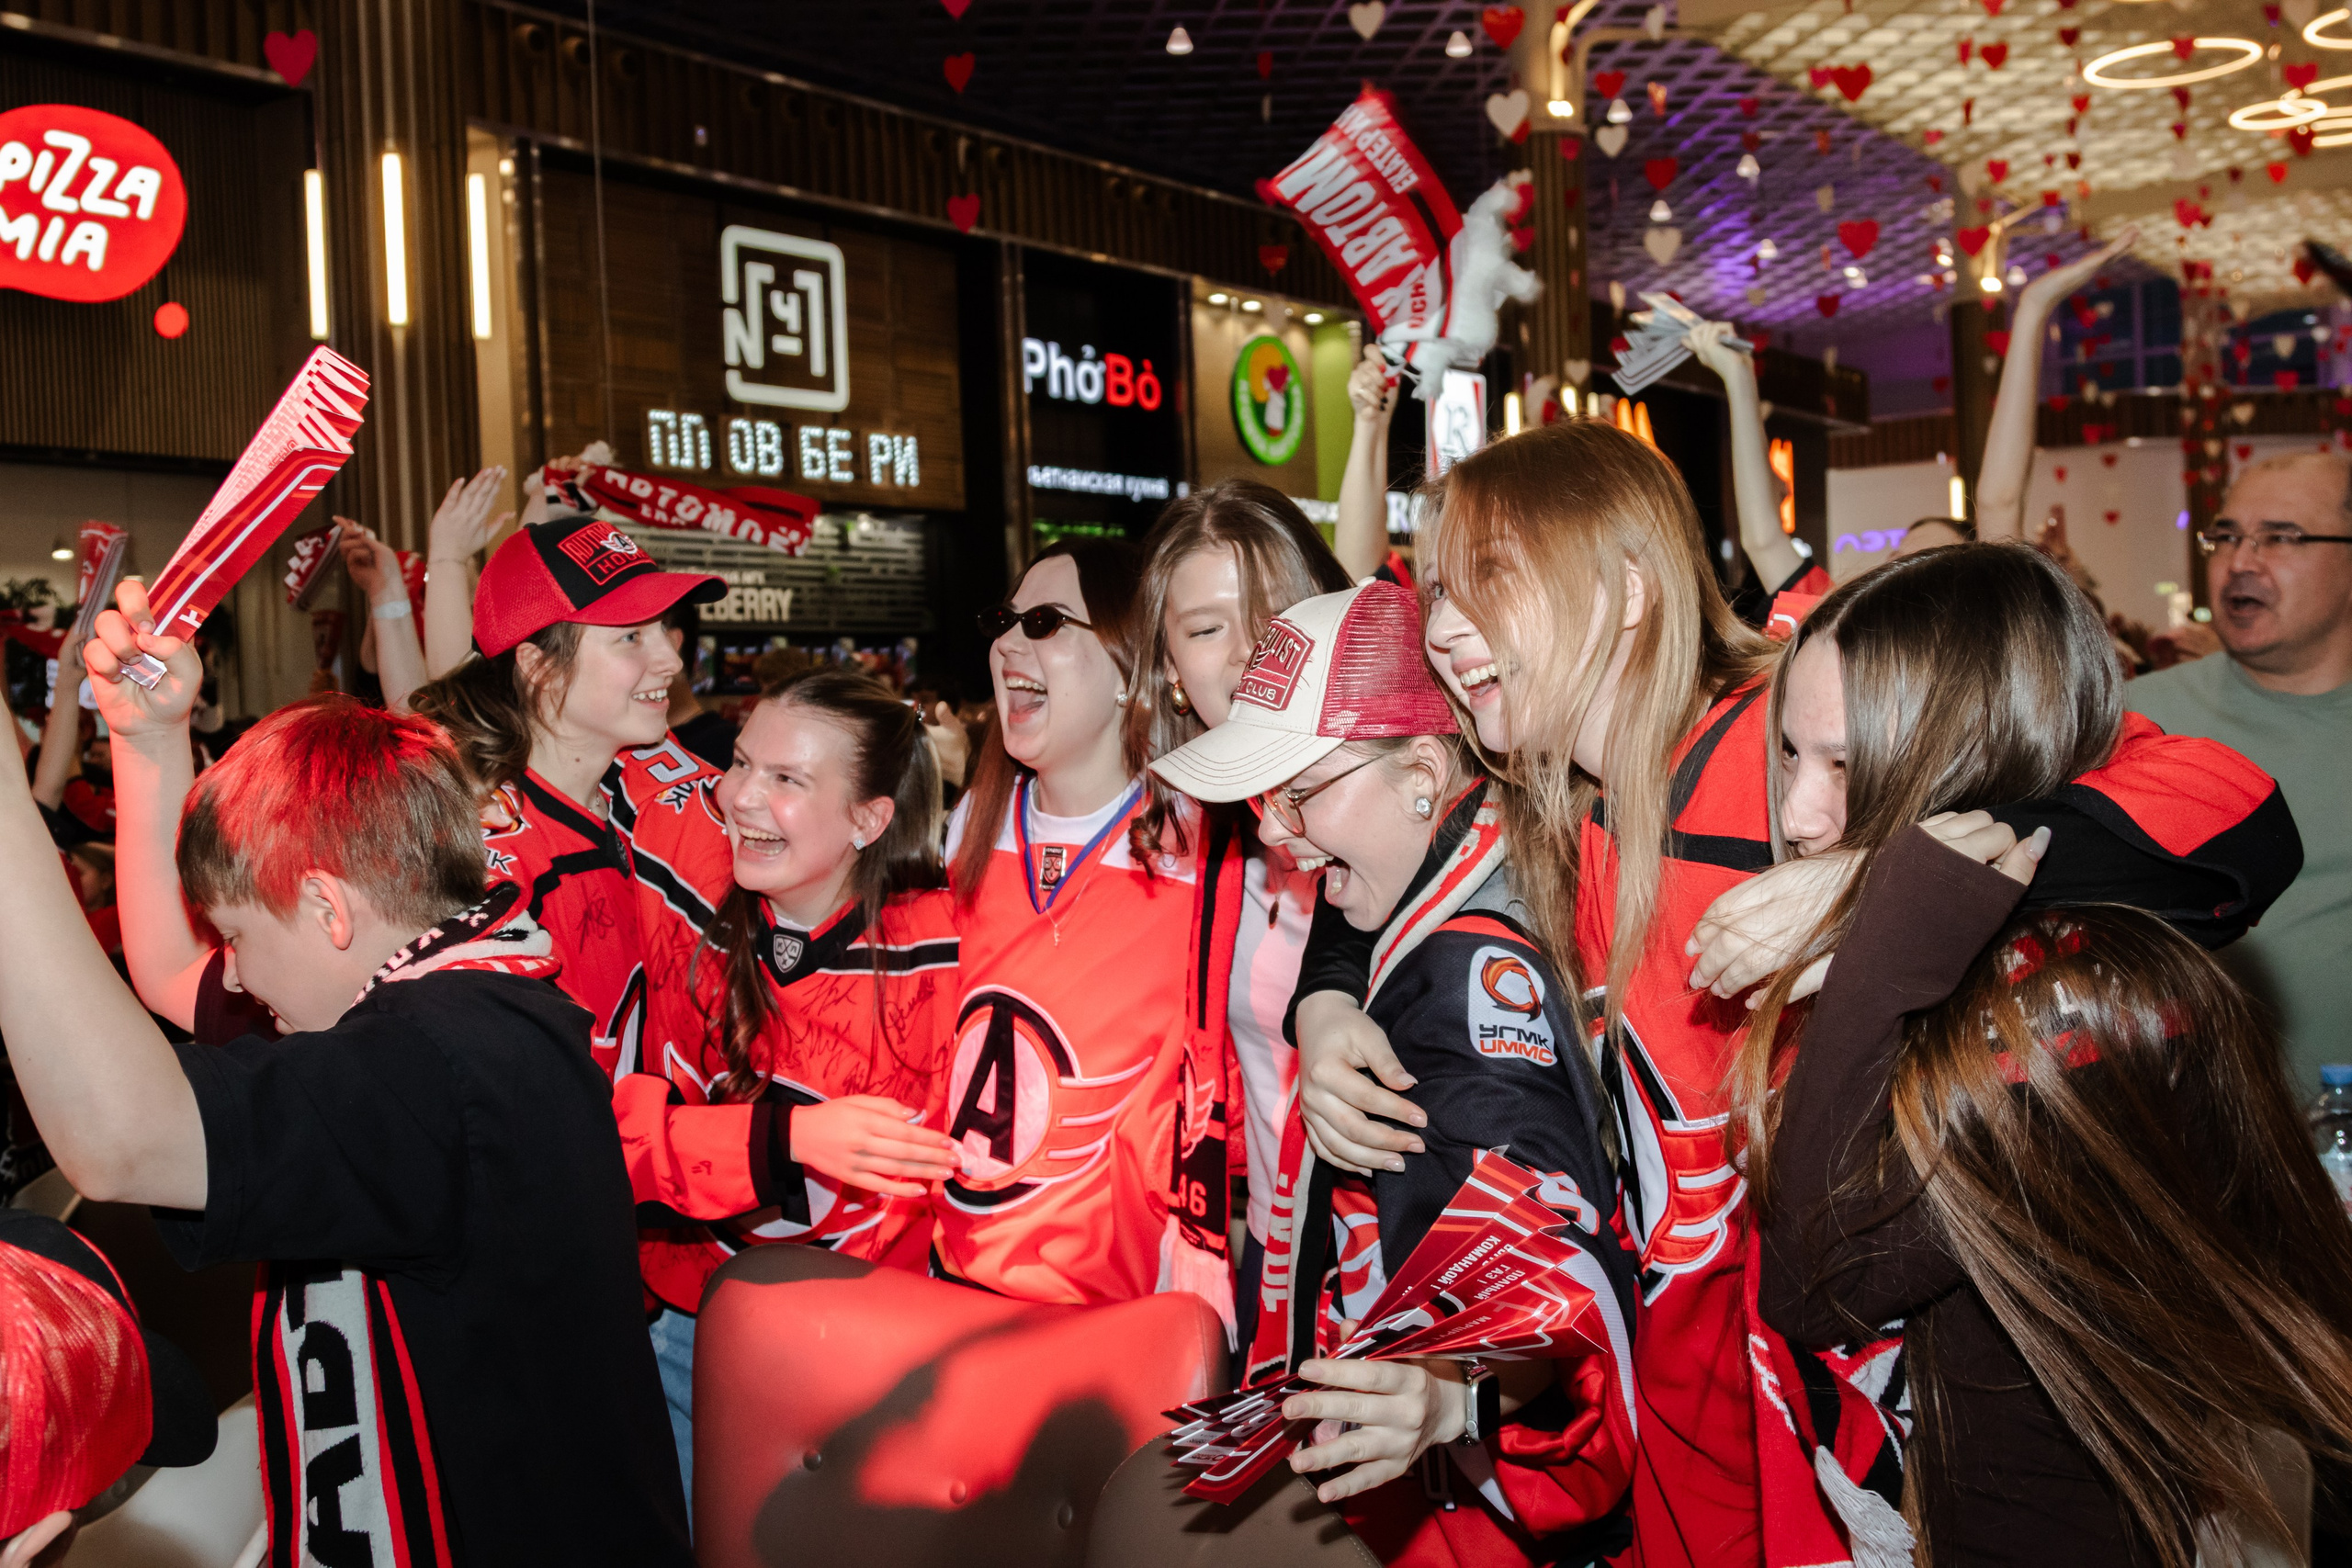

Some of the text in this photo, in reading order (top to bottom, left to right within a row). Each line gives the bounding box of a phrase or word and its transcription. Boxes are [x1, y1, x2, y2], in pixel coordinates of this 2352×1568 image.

[0, 129, 162, 220] PIZZA
[1273, 138, 1419, 287] АВТОМ
[1245, 681, 1277, 701] CLUB
[1479, 1023, 1551, 1050] УГМК
[1479, 1039, 1554, 1064] UMMC
[1437, 1235, 1501, 1286] КОМАНДОЙ
[1485, 1263, 1511, 1280] ГАЗ
[1474, 1269, 1526, 1301] ПОЛНЫЙ
